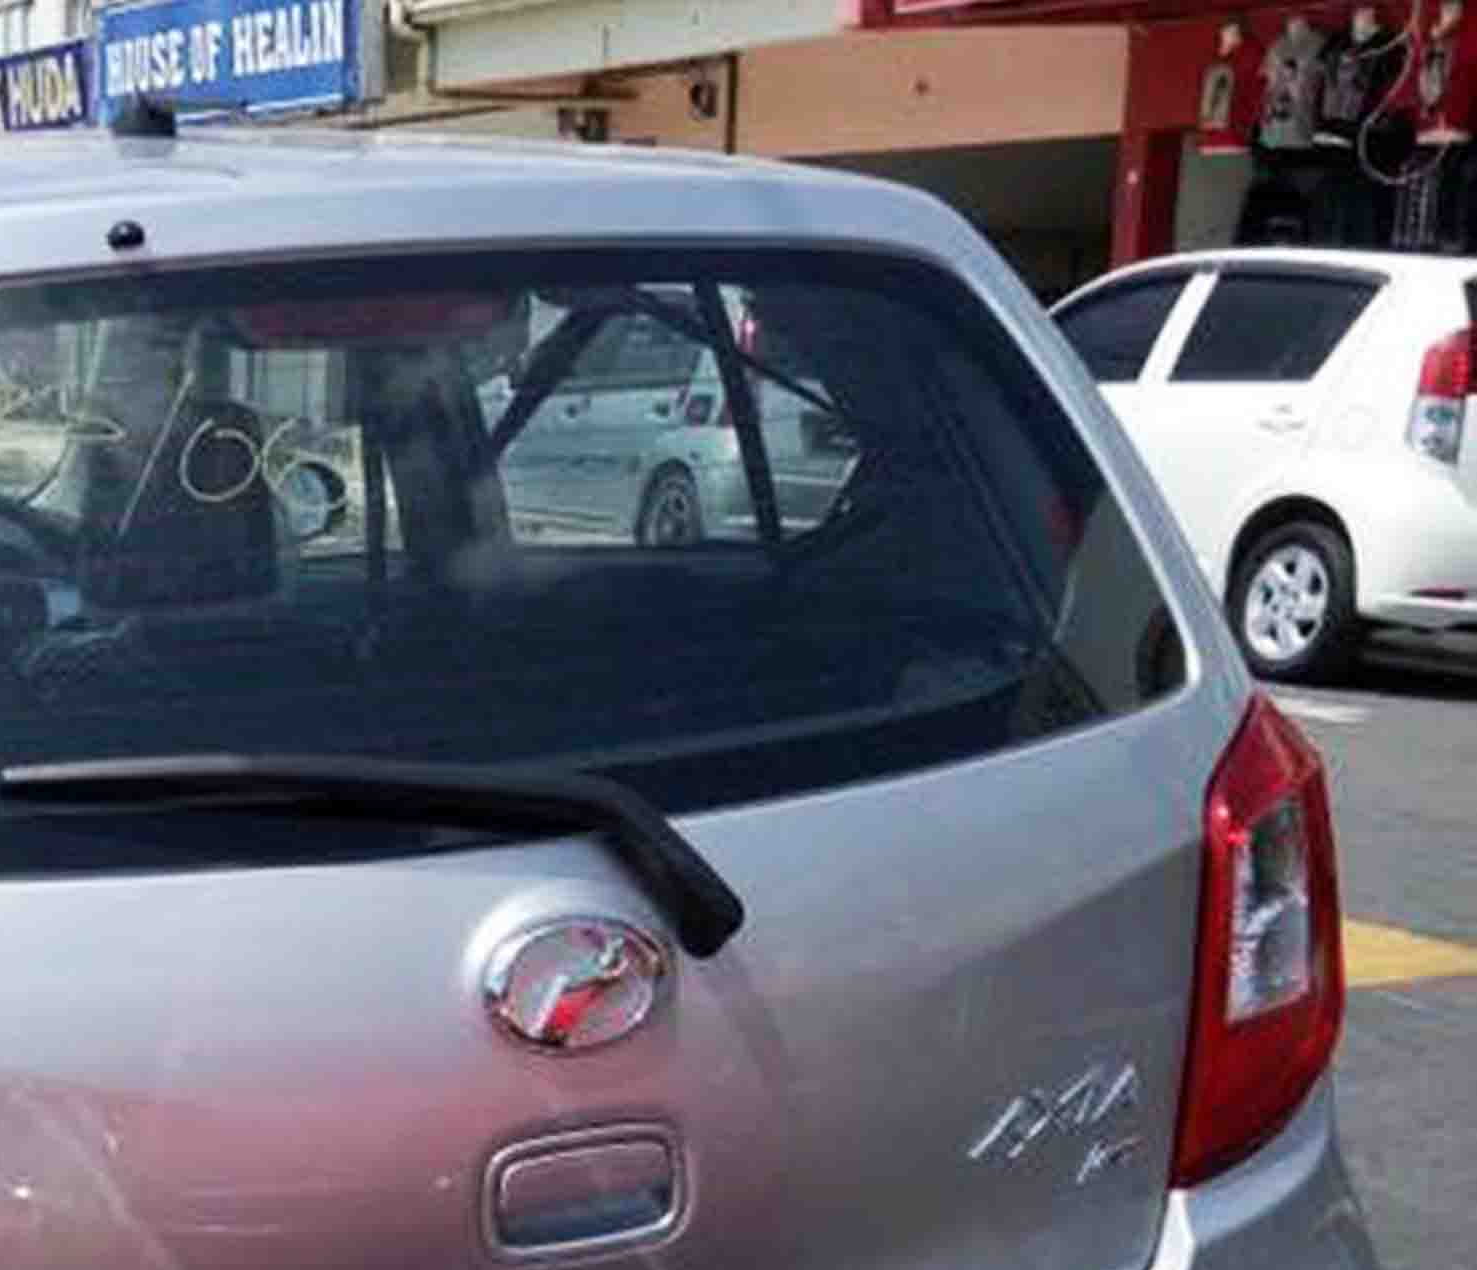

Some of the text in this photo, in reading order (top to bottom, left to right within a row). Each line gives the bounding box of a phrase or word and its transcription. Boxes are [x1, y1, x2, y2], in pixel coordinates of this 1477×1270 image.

[10, 51, 83, 129] HUDA
[104, 0, 344, 97] HOUSE OF HEALIN
